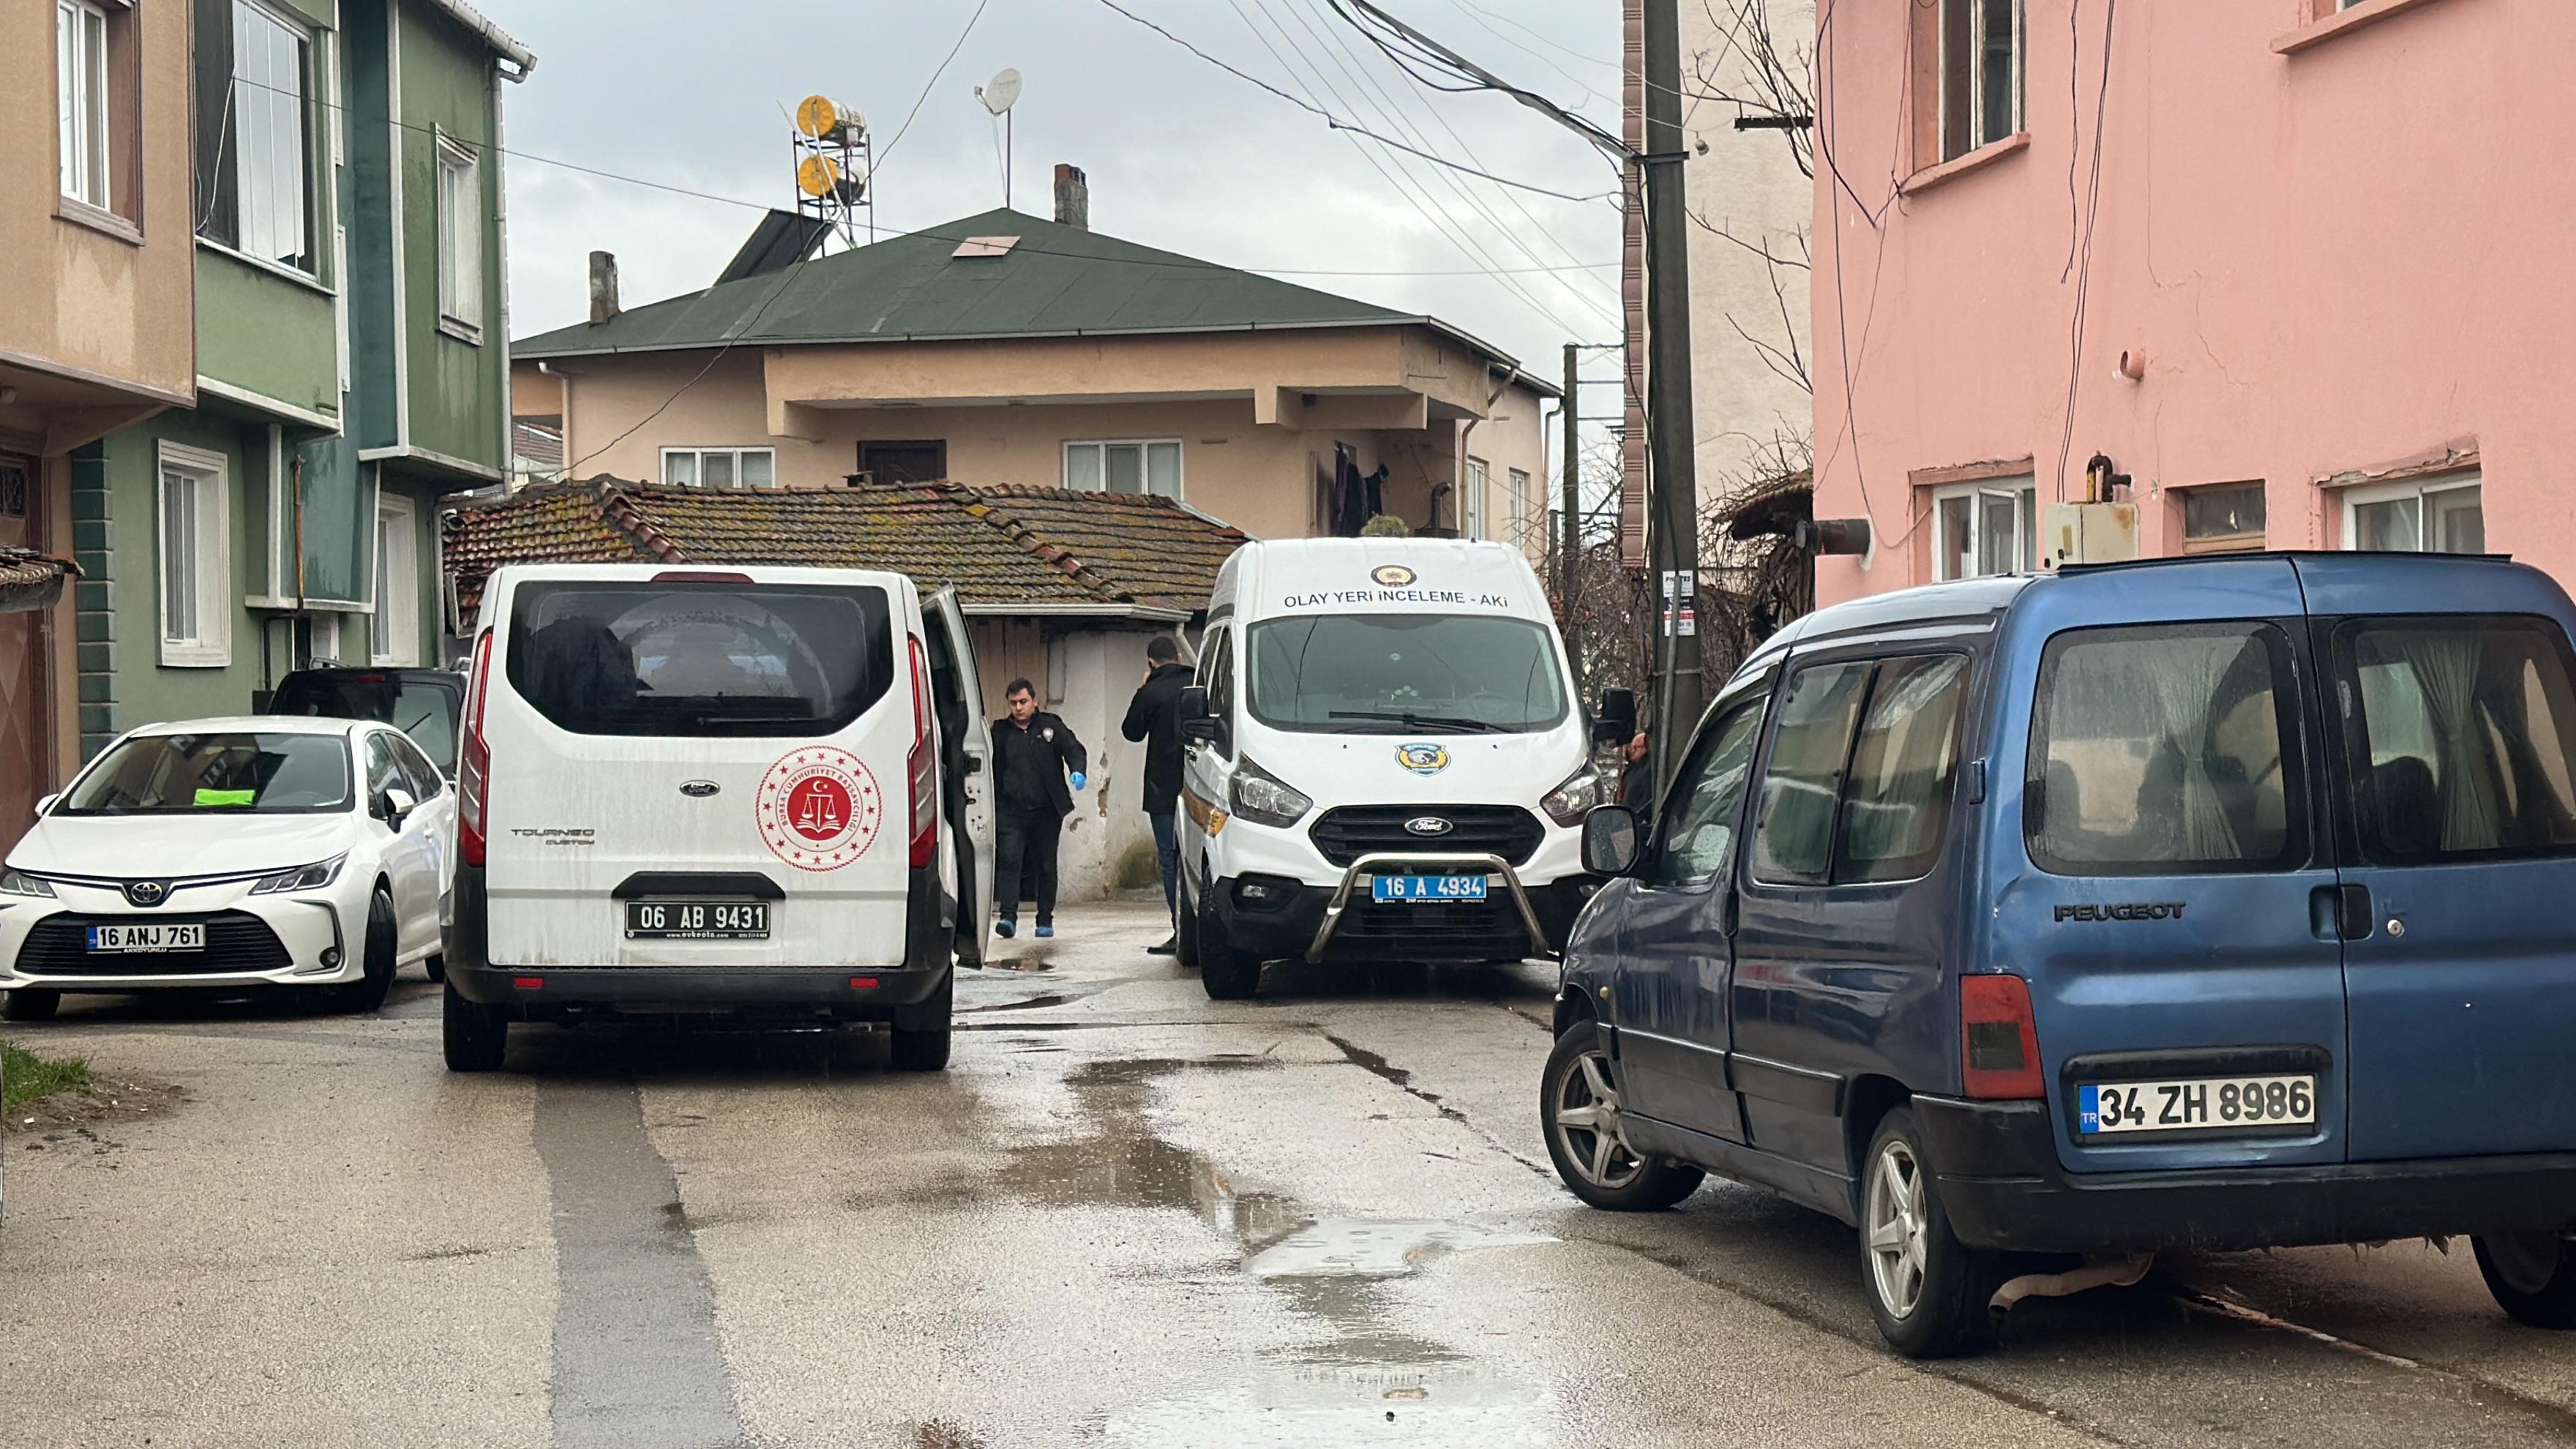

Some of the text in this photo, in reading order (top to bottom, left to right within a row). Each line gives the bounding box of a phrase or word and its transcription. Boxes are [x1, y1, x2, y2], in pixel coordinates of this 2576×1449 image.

[1284, 593, 1328, 608] OLAY
[779, 797, 788, 826] BURSA
[785, 767, 836, 795] CUMHURİYET
[511, 828, 595, 836] TOURNEO
[1415, 819, 1442, 831] Ford
[1385, 877, 1482, 896] 16 A 4934
[641, 905, 763, 929] 06 AB 9431
[2053, 901, 2187, 923] PEUGEOT
[100, 927, 119, 946] 16
[126, 926, 160, 946] ANJ
[168, 926, 199, 946] 761
[2082, 1080, 2312, 1126] TR 34 ZH 8986
